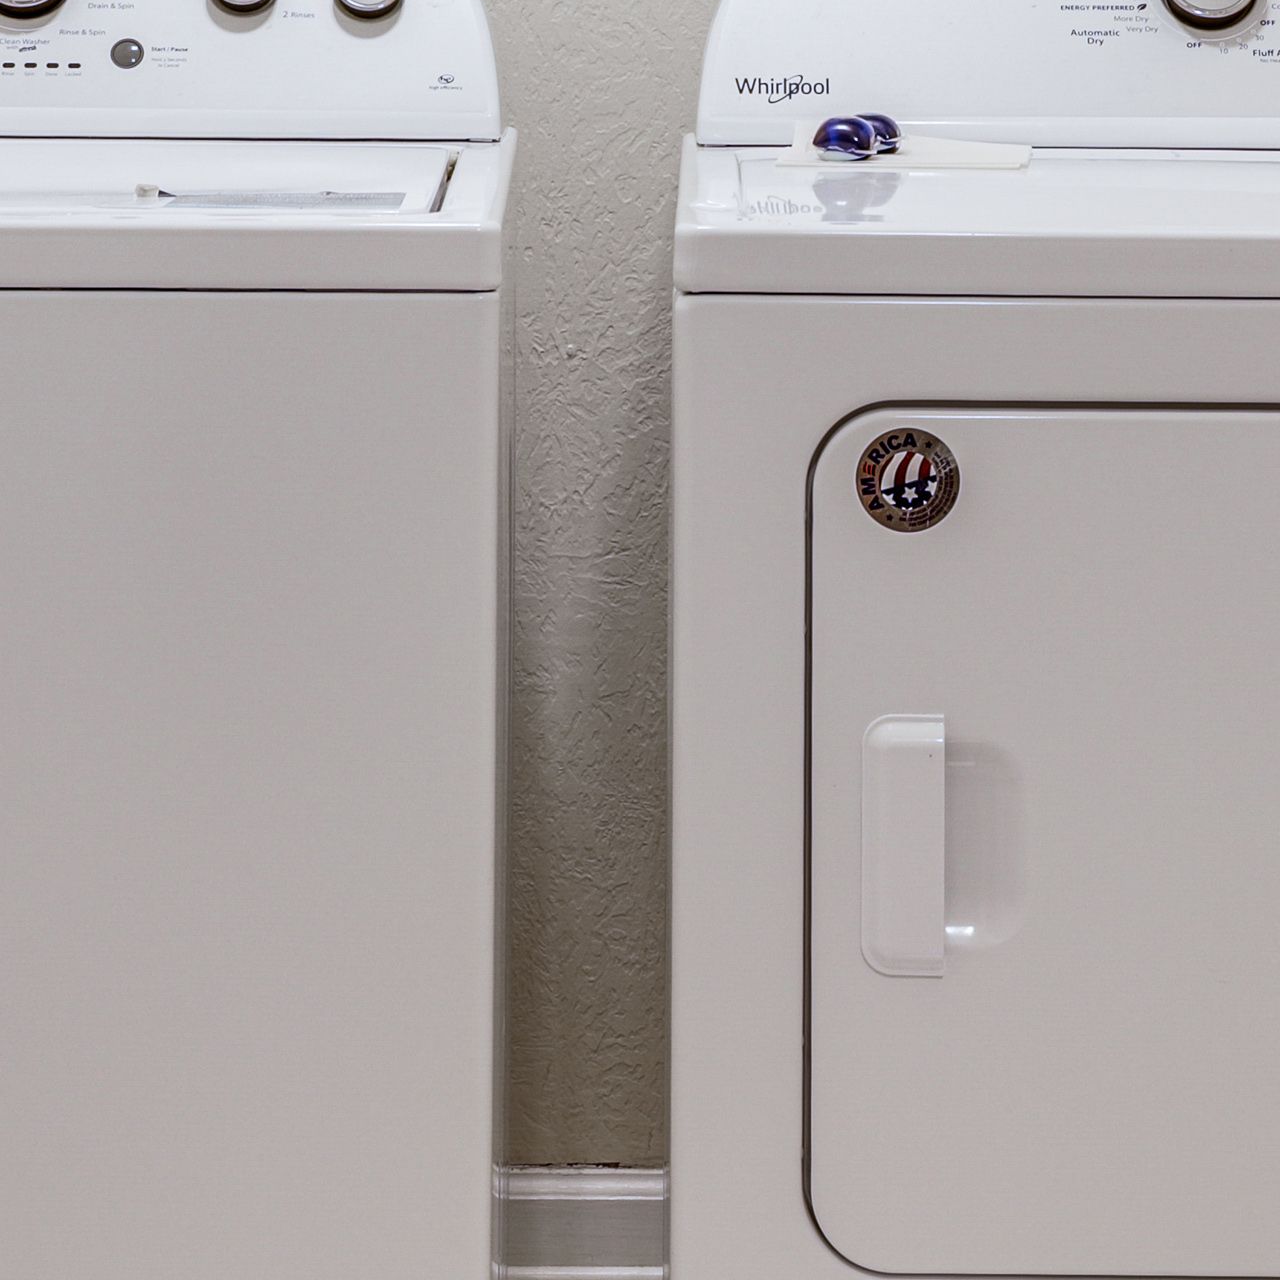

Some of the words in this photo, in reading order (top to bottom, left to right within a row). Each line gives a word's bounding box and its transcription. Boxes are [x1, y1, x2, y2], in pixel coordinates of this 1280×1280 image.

[1071, 29, 1120, 37] Automatic
[1087, 38, 1104, 46] Dry
[735, 75, 830, 103] Whirlpool
[861, 433, 917, 510] AMERICA
